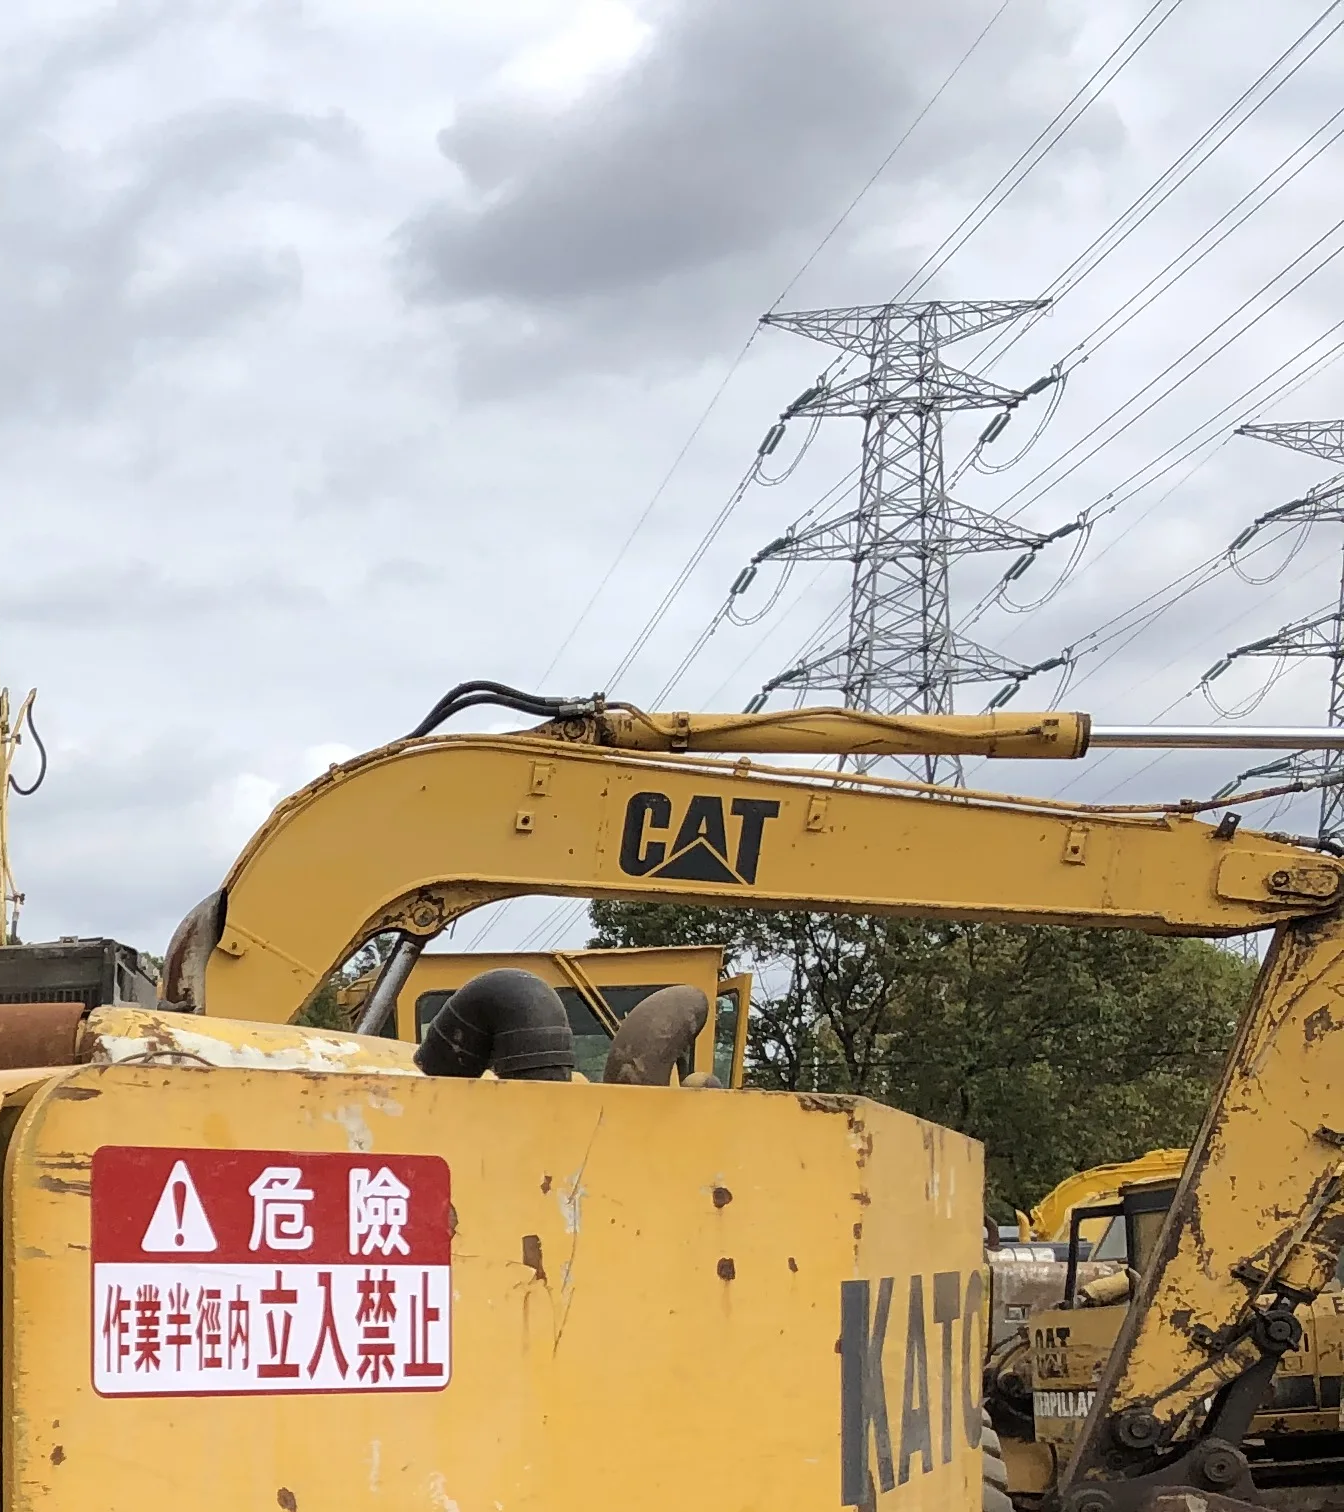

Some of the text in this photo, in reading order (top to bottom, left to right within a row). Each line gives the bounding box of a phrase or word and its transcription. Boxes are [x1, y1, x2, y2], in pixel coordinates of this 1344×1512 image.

[619, 792, 780, 885] CAT
[248, 1166, 411, 1256] 危險
[840, 1270, 983, 1506] KATO
